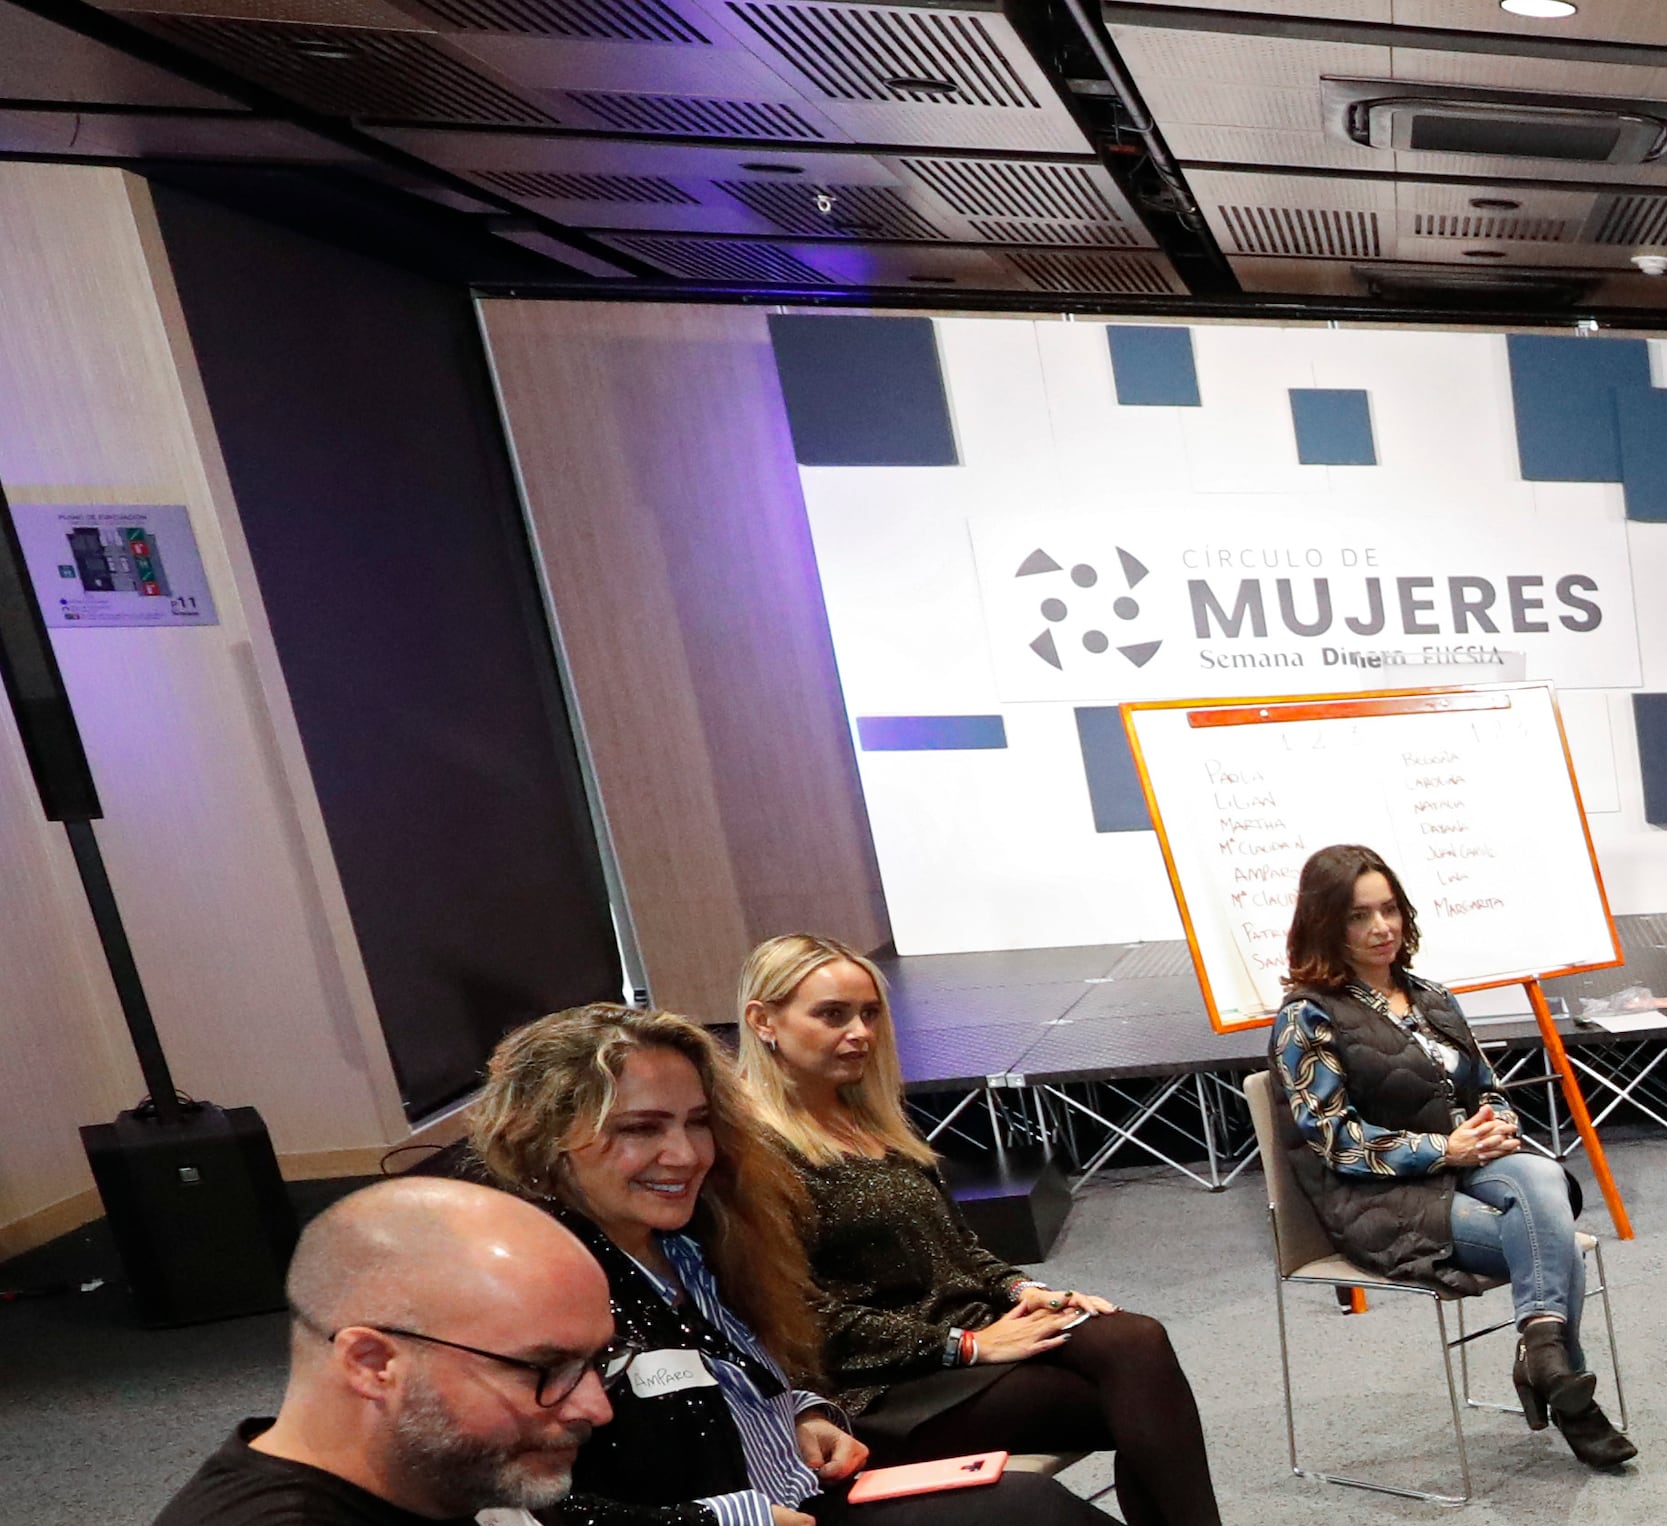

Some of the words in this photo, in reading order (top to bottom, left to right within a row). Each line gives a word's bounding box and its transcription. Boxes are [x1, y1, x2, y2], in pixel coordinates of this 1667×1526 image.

[1182, 544, 1324, 569] CÍRCULO
[1341, 547, 1379, 568] DE
[1186, 573, 1604, 639] MUJERES
[1200, 648, 1304, 669] Semana
[1322, 646, 1408, 670] Dinero
[1219, 817, 1287, 834] MARTHA
[634, 1368, 695, 1388] AMPARO
